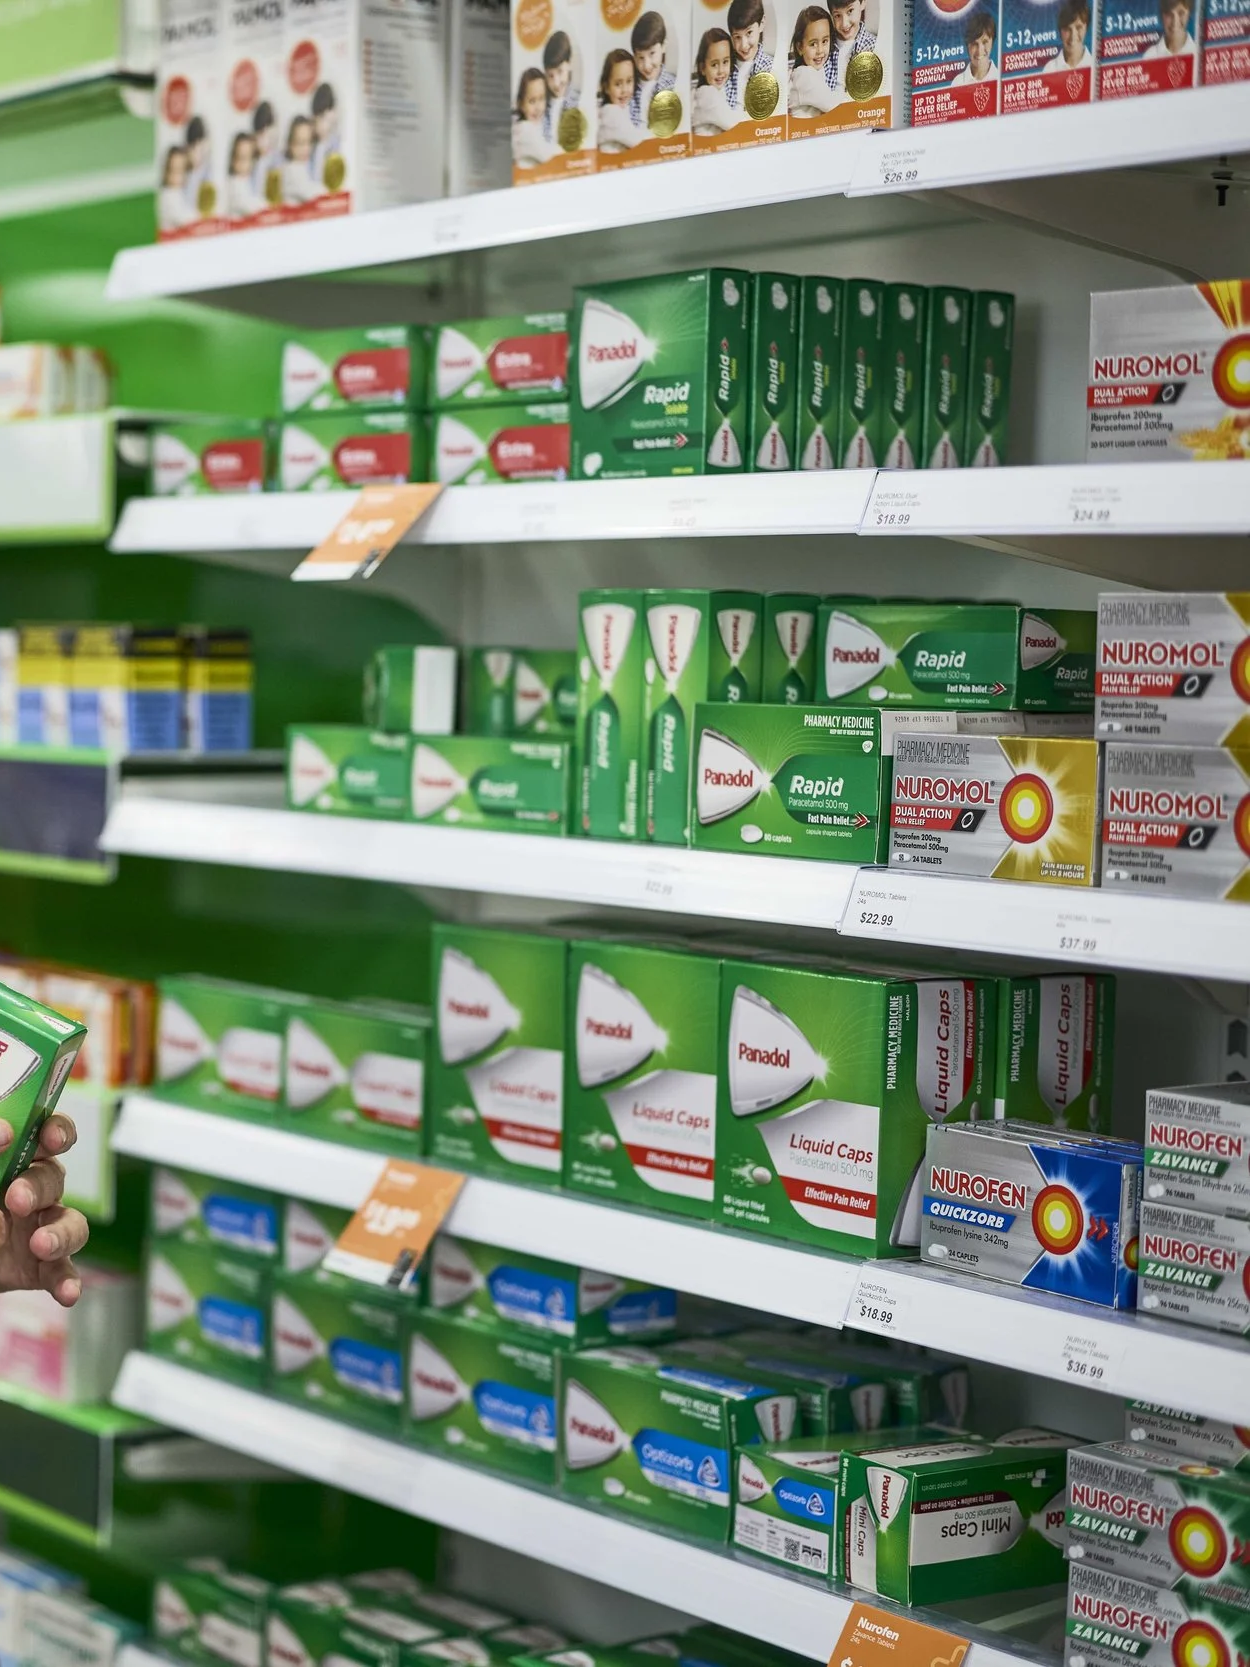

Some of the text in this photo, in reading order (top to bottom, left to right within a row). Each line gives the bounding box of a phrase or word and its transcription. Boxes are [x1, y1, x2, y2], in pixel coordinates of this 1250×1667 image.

[1006, 30, 1057, 47] 5-12 years
[915, 45, 964, 62] 5-12 years
[1005, 47, 1058, 63] CONCENTRATED
[915, 62, 966, 78] CONCENTRATED
[1005, 61, 1037, 71] FORMULA
[915, 74, 946, 86] FORMULA
[915, 93, 950, 106] UP TO 8HR
[1004, 88, 1049, 102] FEVER RELIEF
[857, 108, 886, 120] Orange
[915, 101, 958, 115] FEVER RELIEF
[755, 126, 781, 137] Orange
[883, 170, 918, 184] $26.99
[586, 338, 638, 362] Panadol
[1094, 353, 1204, 380] NUROMOL
[719, 354, 730, 401] Rapid
[767, 358, 779, 405] Rapid
[643, 382, 691, 406] Rapid
[1094, 386, 1149, 397] DUAL ACTION
[1091, 411, 1162, 423] Ibuprofen 200mg
[876, 513, 910, 525] $18.99
[1025, 637, 1057, 649] Panadol
[832, 647, 880, 665] Panadol
[914, 650, 966, 671] Rapid
[1102, 641, 1224, 667] NUROMOL
[1056, 667, 1088, 682] Rapid
[1102, 674, 1173, 686] DUAL ACTION
[947, 683, 987, 694] Fast Pain Relief
[804, 715, 874, 729] PHARMACY MEDICINE
[597, 711, 612, 769] Rapid
[663, 714, 677, 773] Rapid
[897, 740, 970, 759] PHARMACY MEDICINE
[704, 768, 754, 788] Panadol
[789, 775, 844, 799] Rapid
[478, 780, 518, 798] Rapid
[896, 776, 995, 804] NUROMOL
[788, 796, 848, 811] Paracetamol 500 mg
[895, 807, 952, 819] DUAL ACTION
[1109, 789, 1229, 820] NUROMOL
[807, 814, 850, 826] Fast Pain Relief
[908, 818, 926, 826] RELIEF
[1109, 822, 1178, 837] DUAL ACTION
[894, 832, 941, 844] Ibuprofen 200mg
[894, 842, 949, 853] Paracetamol 500mg
[1126, 835, 1147, 843] RELIEF
[920, 857, 942, 865] TABLETS
[859, 890, 907, 902] NUROMOL Tablets
[860, 912, 893, 927] $22.99
[1059, 937, 1096, 951] $37.99
[585, 1017, 633, 1041] Panadol
[1011, 989, 1023, 1082] PHARMACY MEDICINE
[887, 995, 899, 1090] PHARMACY MEDICINE
[935, 988, 950, 1114] Liquid Caps
[965, 1026, 973, 1059] Effective
[1055, 983, 1072, 1105] Liquid Caps
[738, 1042, 791, 1069] Panadol
[49, 1057, 69, 1097] Panadol
[632, 1101, 710, 1130] Liquid Caps
[1149, 1095, 1221, 1119] PHARMACY MEDICINE
[790, 1133, 873, 1164] Liquid Caps
[1150, 1123, 1242, 1157] NUROFEN
[1150, 1152, 1219, 1174] ZAVANCE
[931, 1165, 1027, 1210] NUROFEN
[804, 1186, 870, 1211] Effective Pain Relief
[930, 1201, 1004, 1229] QUICKZORB
[1143, 1207, 1215, 1233] PHARMACY MEDICINE
[929, 1220, 1009, 1249] Ibuprofen lysine 342mg
[1111, 1222, 1119, 1264] NUROFEN
[948, 1249, 979, 1263] 24 CAPLETS
[1145, 1234, 1237, 1273] NUROFEN
[1144, 1263, 1213, 1287] ZAVANCE
[857, 1290, 897, 1306] Quickzorb Caps
[859, 1282, 887, 1295] NUROFEN
[855, 1297, 865, 1305] 24s
[859, 1305, 893, 1324] $18.99
[1066, 1359, 1104, 1379] $36.99
[570, 1416, 616, 1444] Panadol
[642, 1443, 694, 1473] Optizorb
[1069, 1456, 1155, 1492] PHARMACY MEDICINE
[779, 1489, 807, 1506] Optizorb
[880, 1475, 891, 1519] Panadol
[1071, 1481, 1165, 1528] NUROFEN
[954, 1505, 1012, 1520] Paracetamol 500 mg
[857, 1506, 867, 1557] Mini Caps
[940, 1516, 1012, 1538] Mini Caps
[1070, 1513, 1137, 1541] ZAVANCE
[1071, 1566, 1158, 1602] PHARMACY MEDICINE
[1073, 1592, 1169, 1640] NUROFEN
[857, 1616, 900, 1641] Nurofen
[1072, 1624, 1141, 1654] ZAVANCE
[850, 1636, 861, 1645] 24s
[853, 1629, 896, 1650] Zavance Tablets
